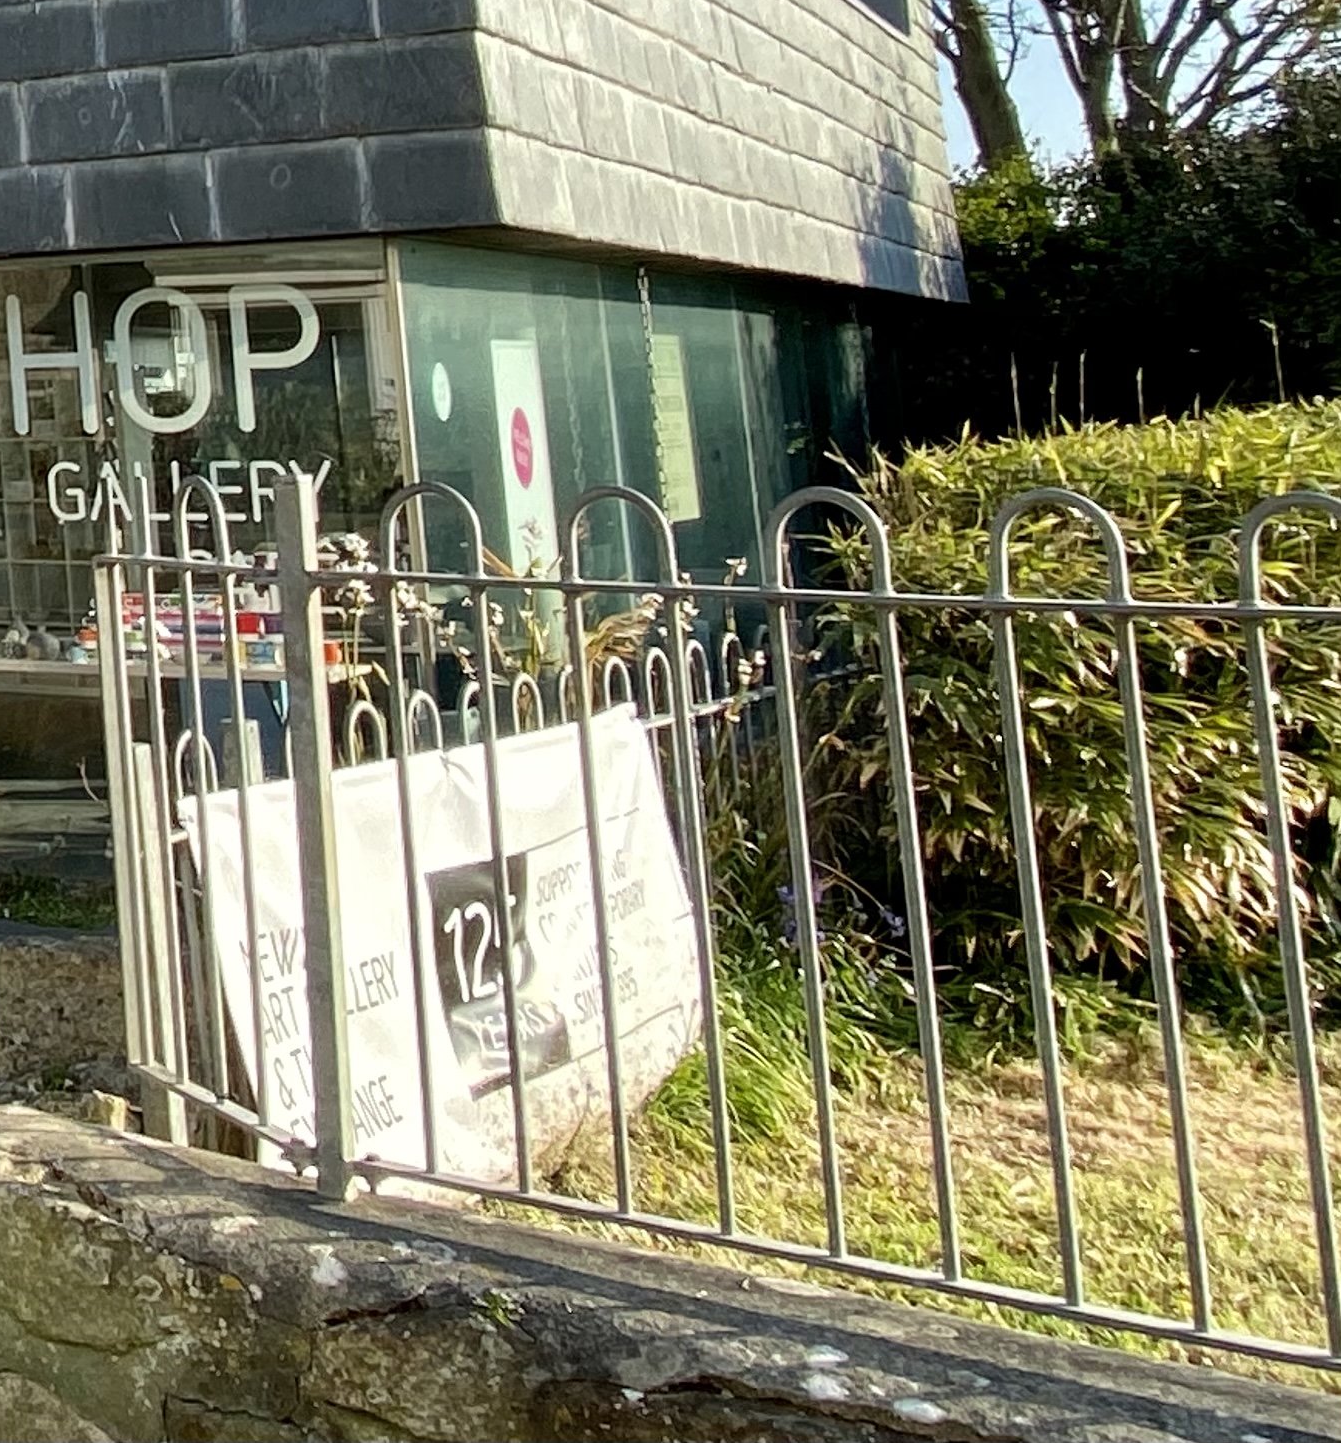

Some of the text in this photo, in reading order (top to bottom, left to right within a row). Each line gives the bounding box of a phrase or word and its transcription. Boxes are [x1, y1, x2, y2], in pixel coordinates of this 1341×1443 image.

[47, 459, 332, 523] GALLERY
[260, 985, 300, 1049] ART
[274, 1057, 297, 1111] &
